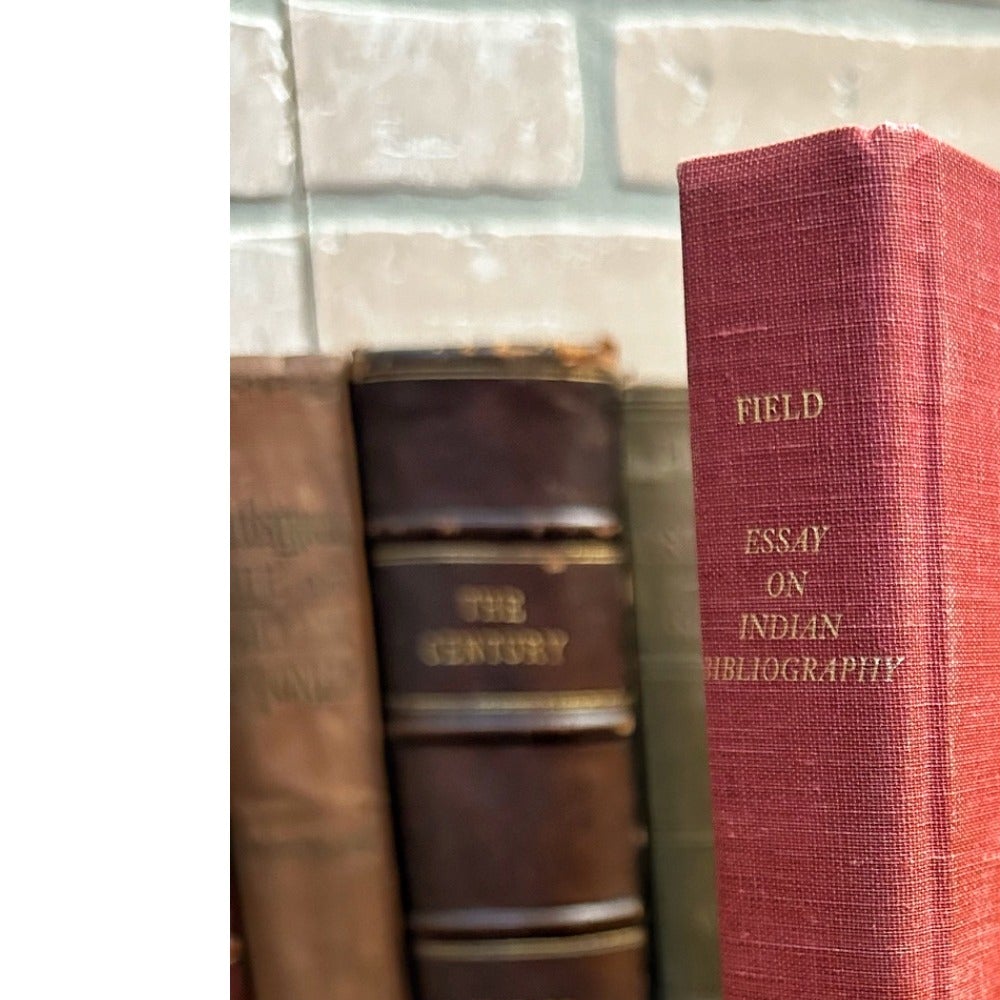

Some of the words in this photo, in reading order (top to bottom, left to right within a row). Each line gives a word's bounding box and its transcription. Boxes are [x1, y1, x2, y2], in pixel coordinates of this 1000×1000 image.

[738, 391, 823, 424] FIELD
[744, 524, 830, 554] ESSAY
[767, 569, 808, 598] ON
[454, 584, 527, 624] THE
[739, 613, 843, 641] INDIAN
[417, 627, 569, 667] CENTURY
